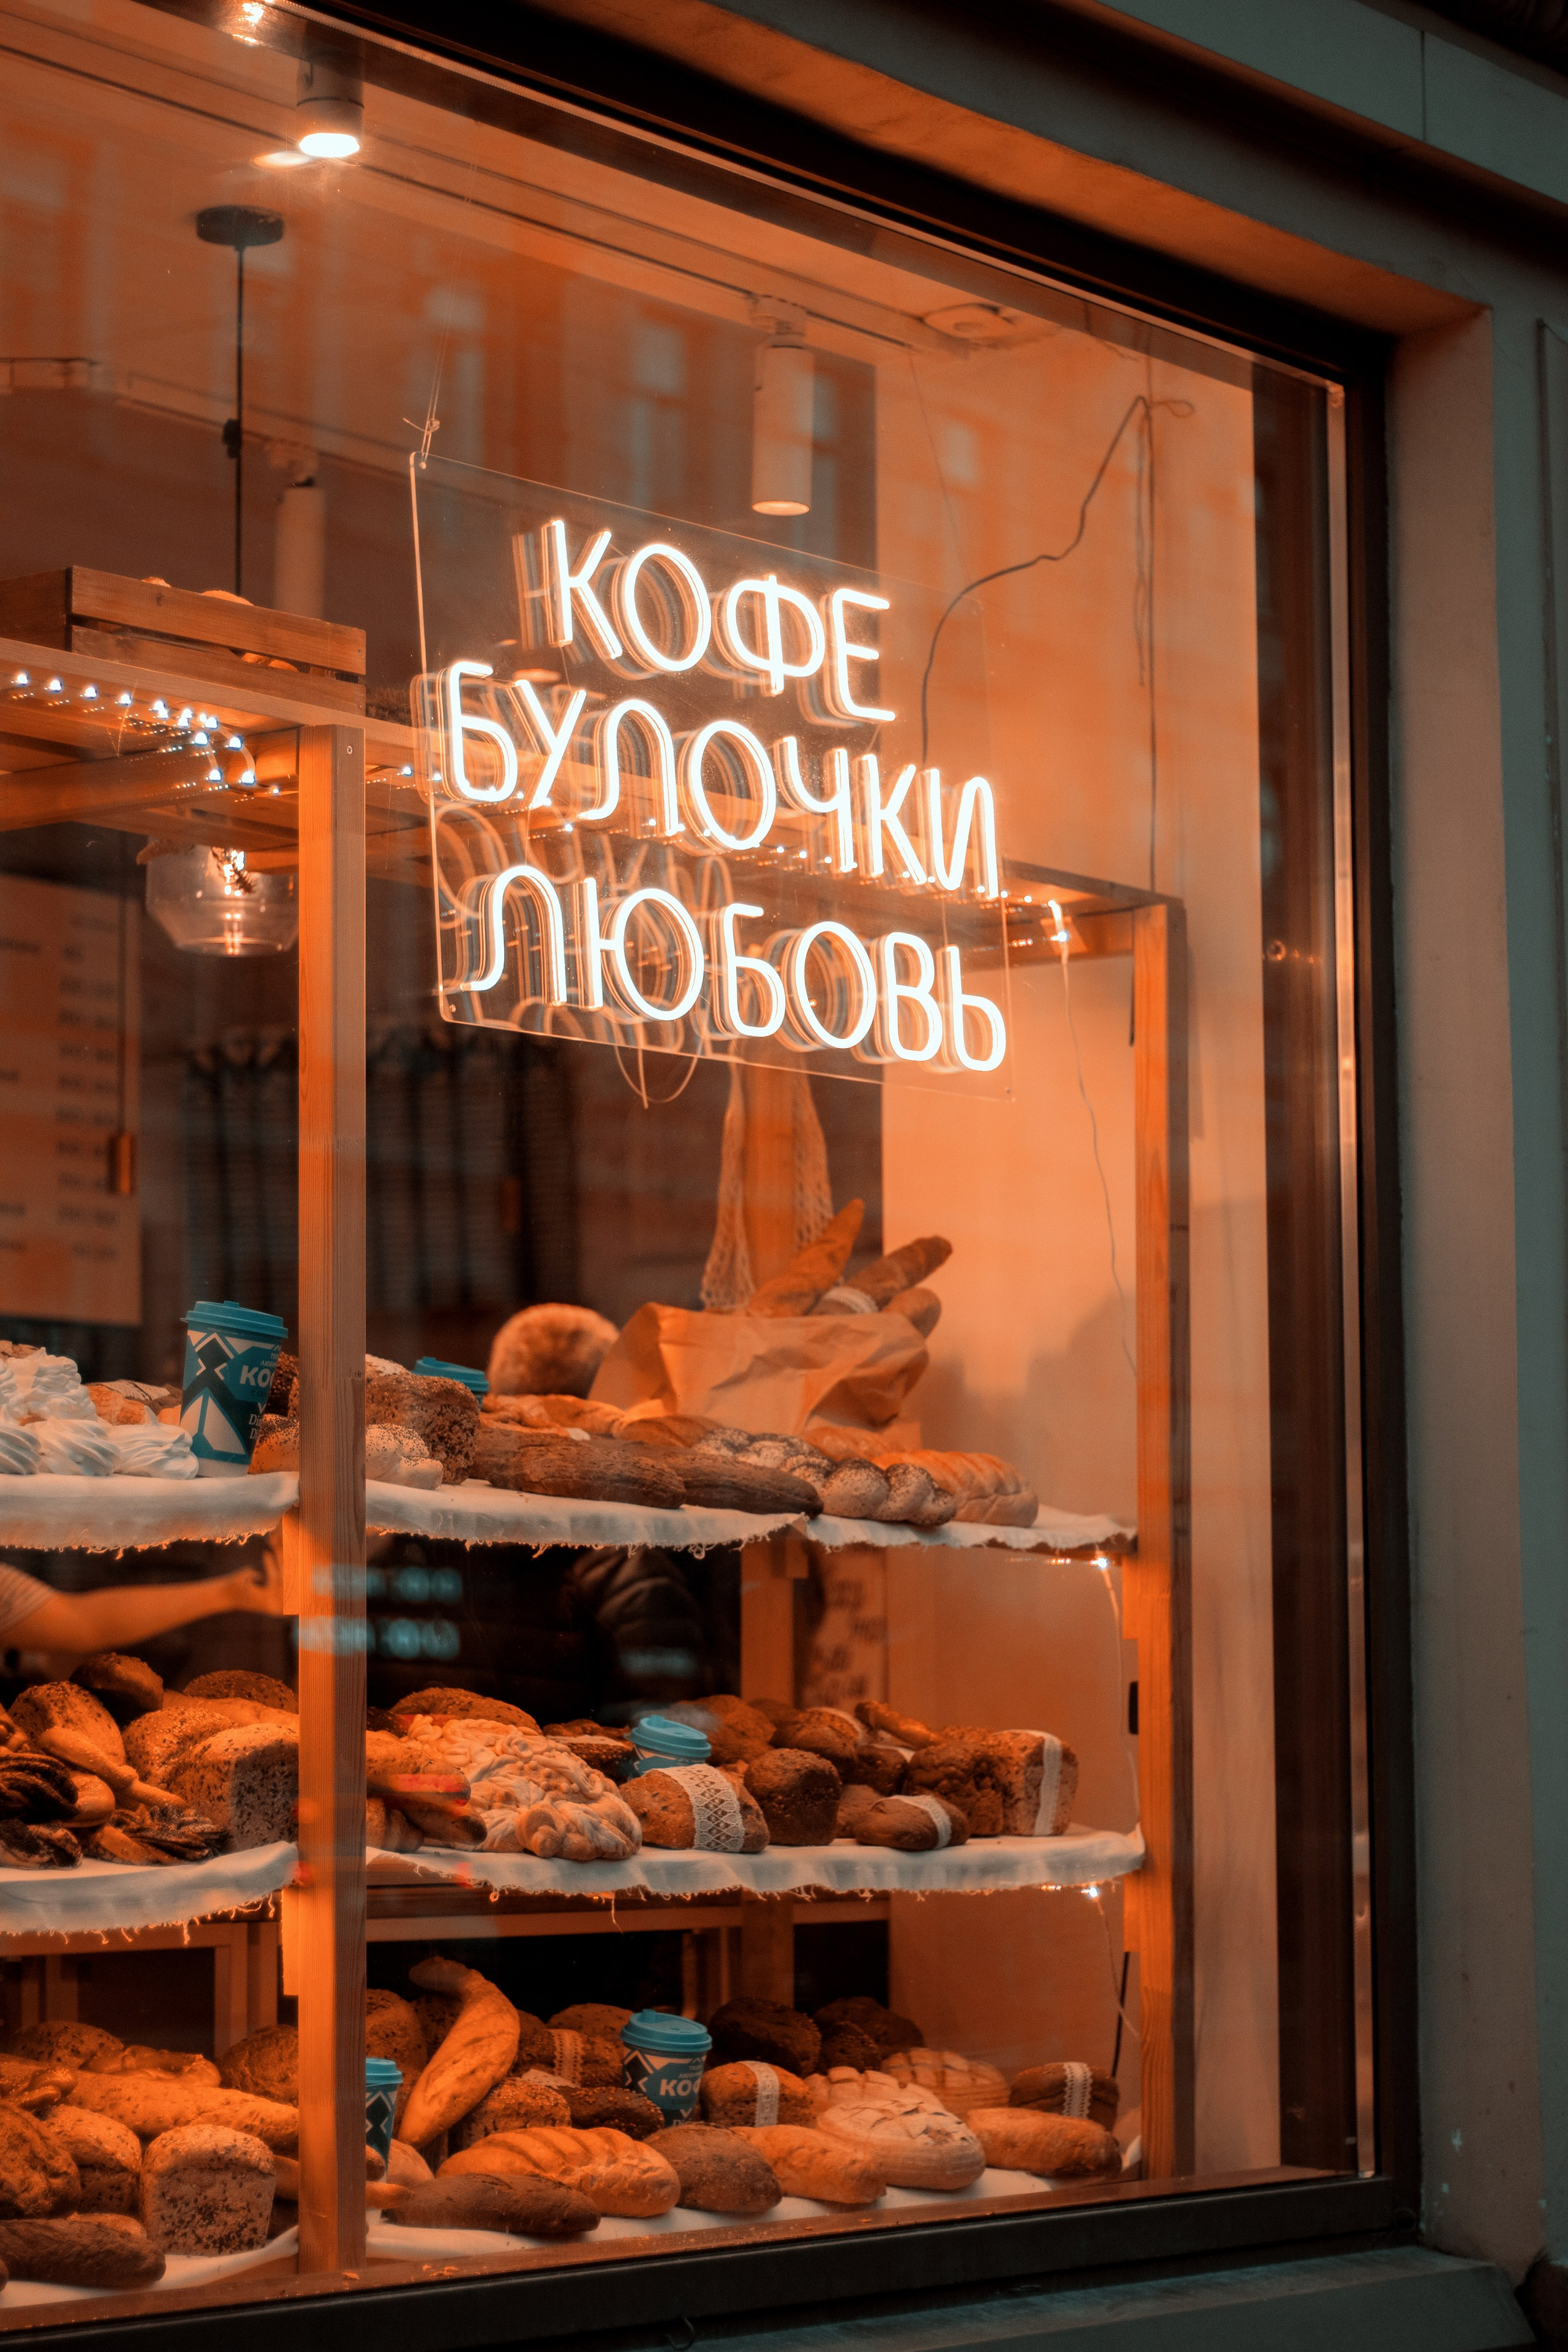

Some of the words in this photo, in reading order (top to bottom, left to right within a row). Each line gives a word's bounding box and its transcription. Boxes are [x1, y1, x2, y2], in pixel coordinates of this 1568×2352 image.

[546, 520, 896, 722] КОФЕ
[447, 661, 1001, 900] БУЛОЧКИ
[459, 865, 1007, 1071] ЛЮБОВЬ
